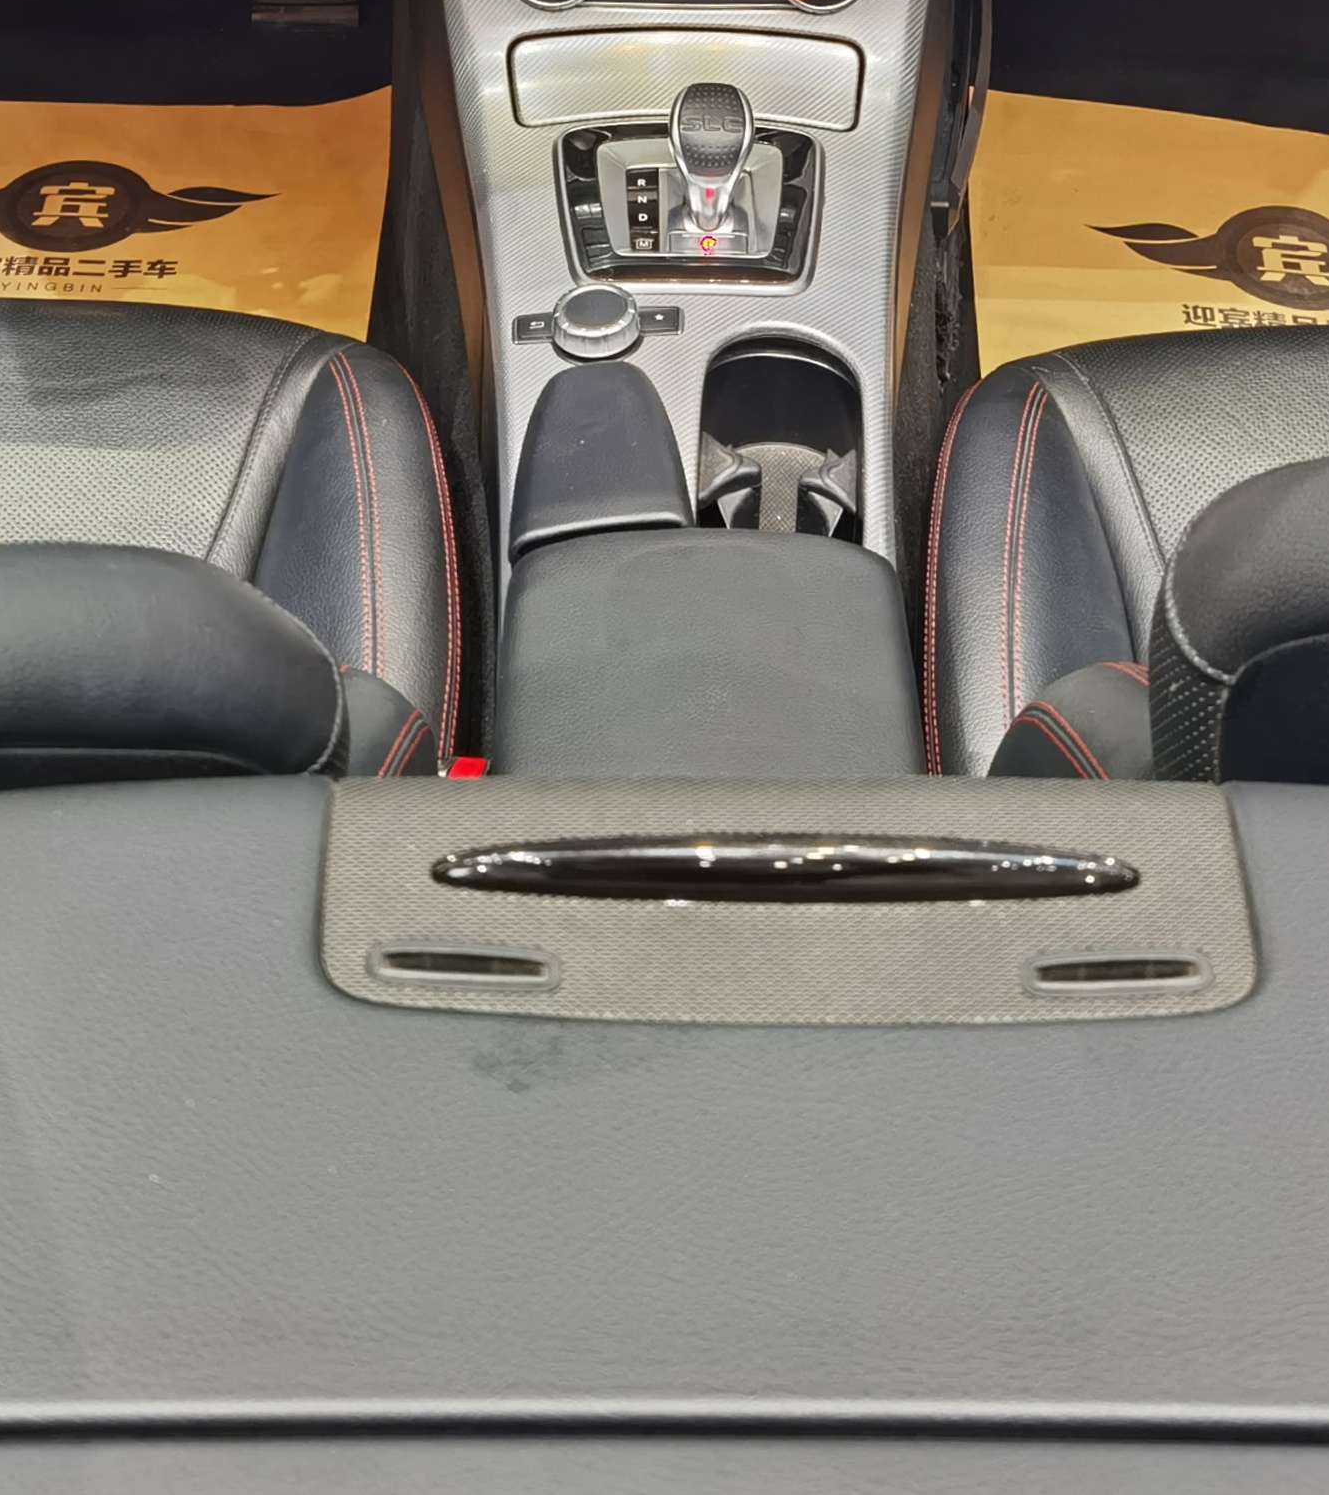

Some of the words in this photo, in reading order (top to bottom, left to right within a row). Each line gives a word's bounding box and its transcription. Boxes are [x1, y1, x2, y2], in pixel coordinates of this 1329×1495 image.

[680, 114, 745, 134] SLC
[637, 178, 647, 188] R
[31, 181, 116, 229] 宾
[637, 195, 648, 204] N
[638, 213, 648, 222] D
[0, 281, 105, 294] YINGBIN
